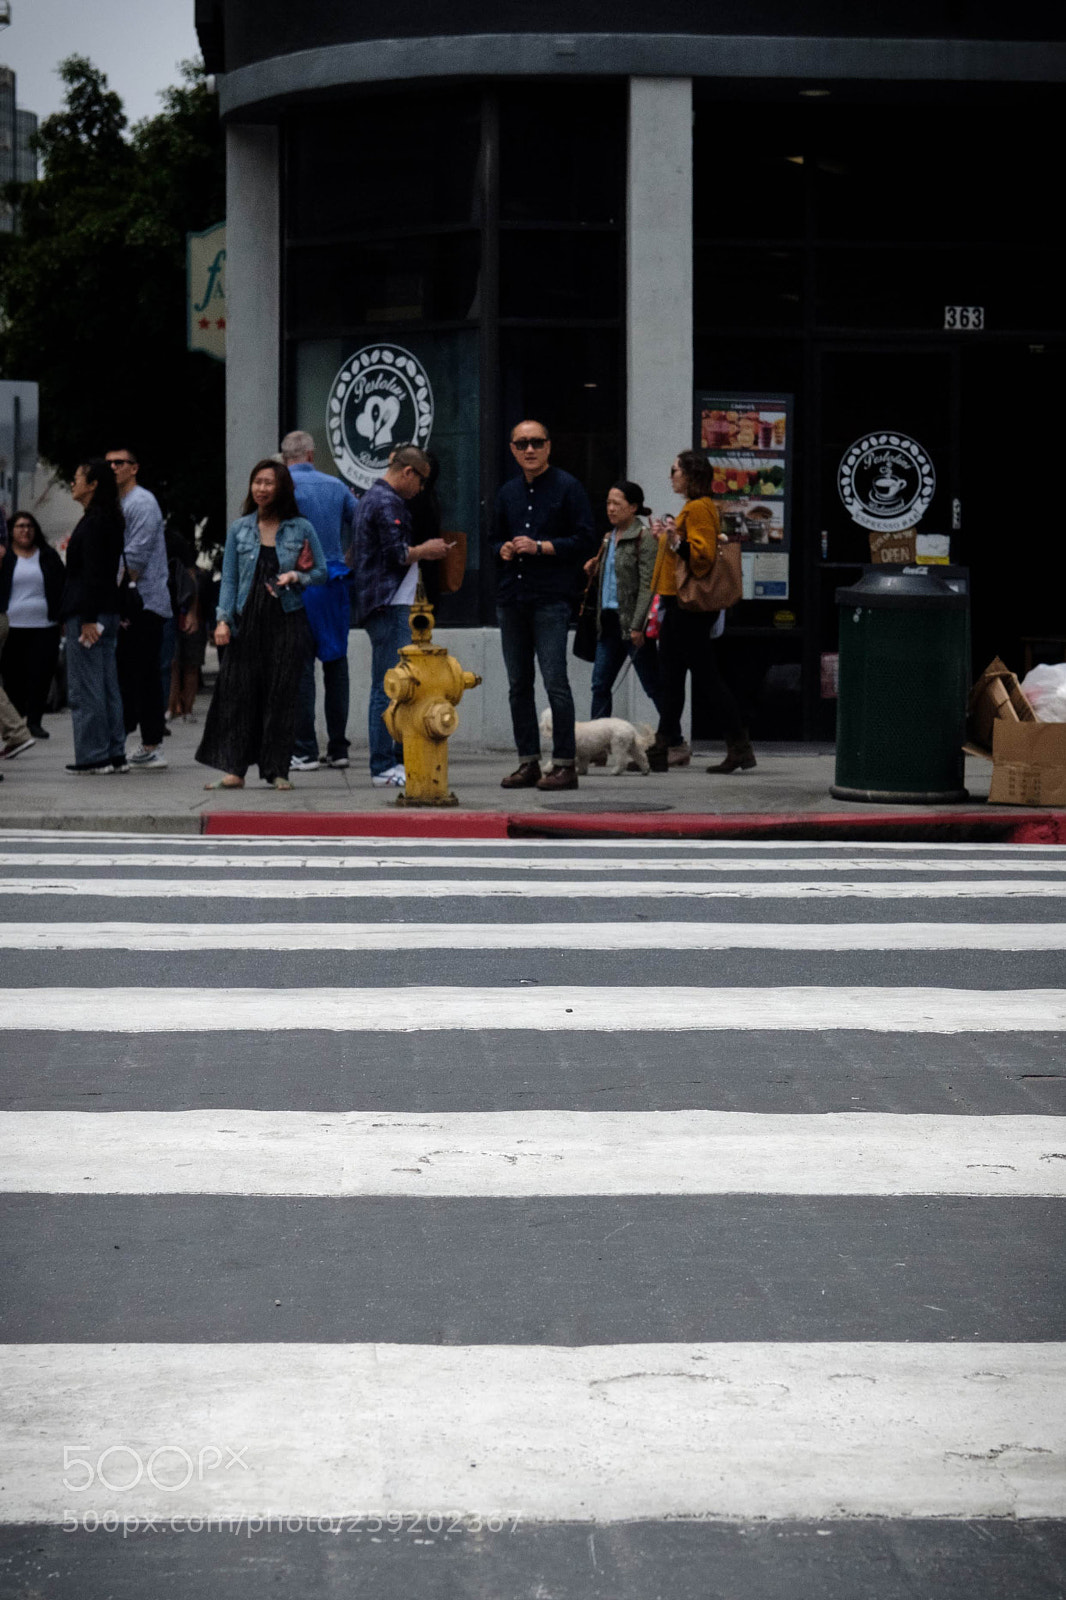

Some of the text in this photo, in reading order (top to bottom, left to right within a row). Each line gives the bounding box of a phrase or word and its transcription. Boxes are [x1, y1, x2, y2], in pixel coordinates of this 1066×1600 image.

[947, 308, 981, 327] 363
[855, 512, 900, 529] ESPRESSO
[880, 546, 910, 563] OPEN
